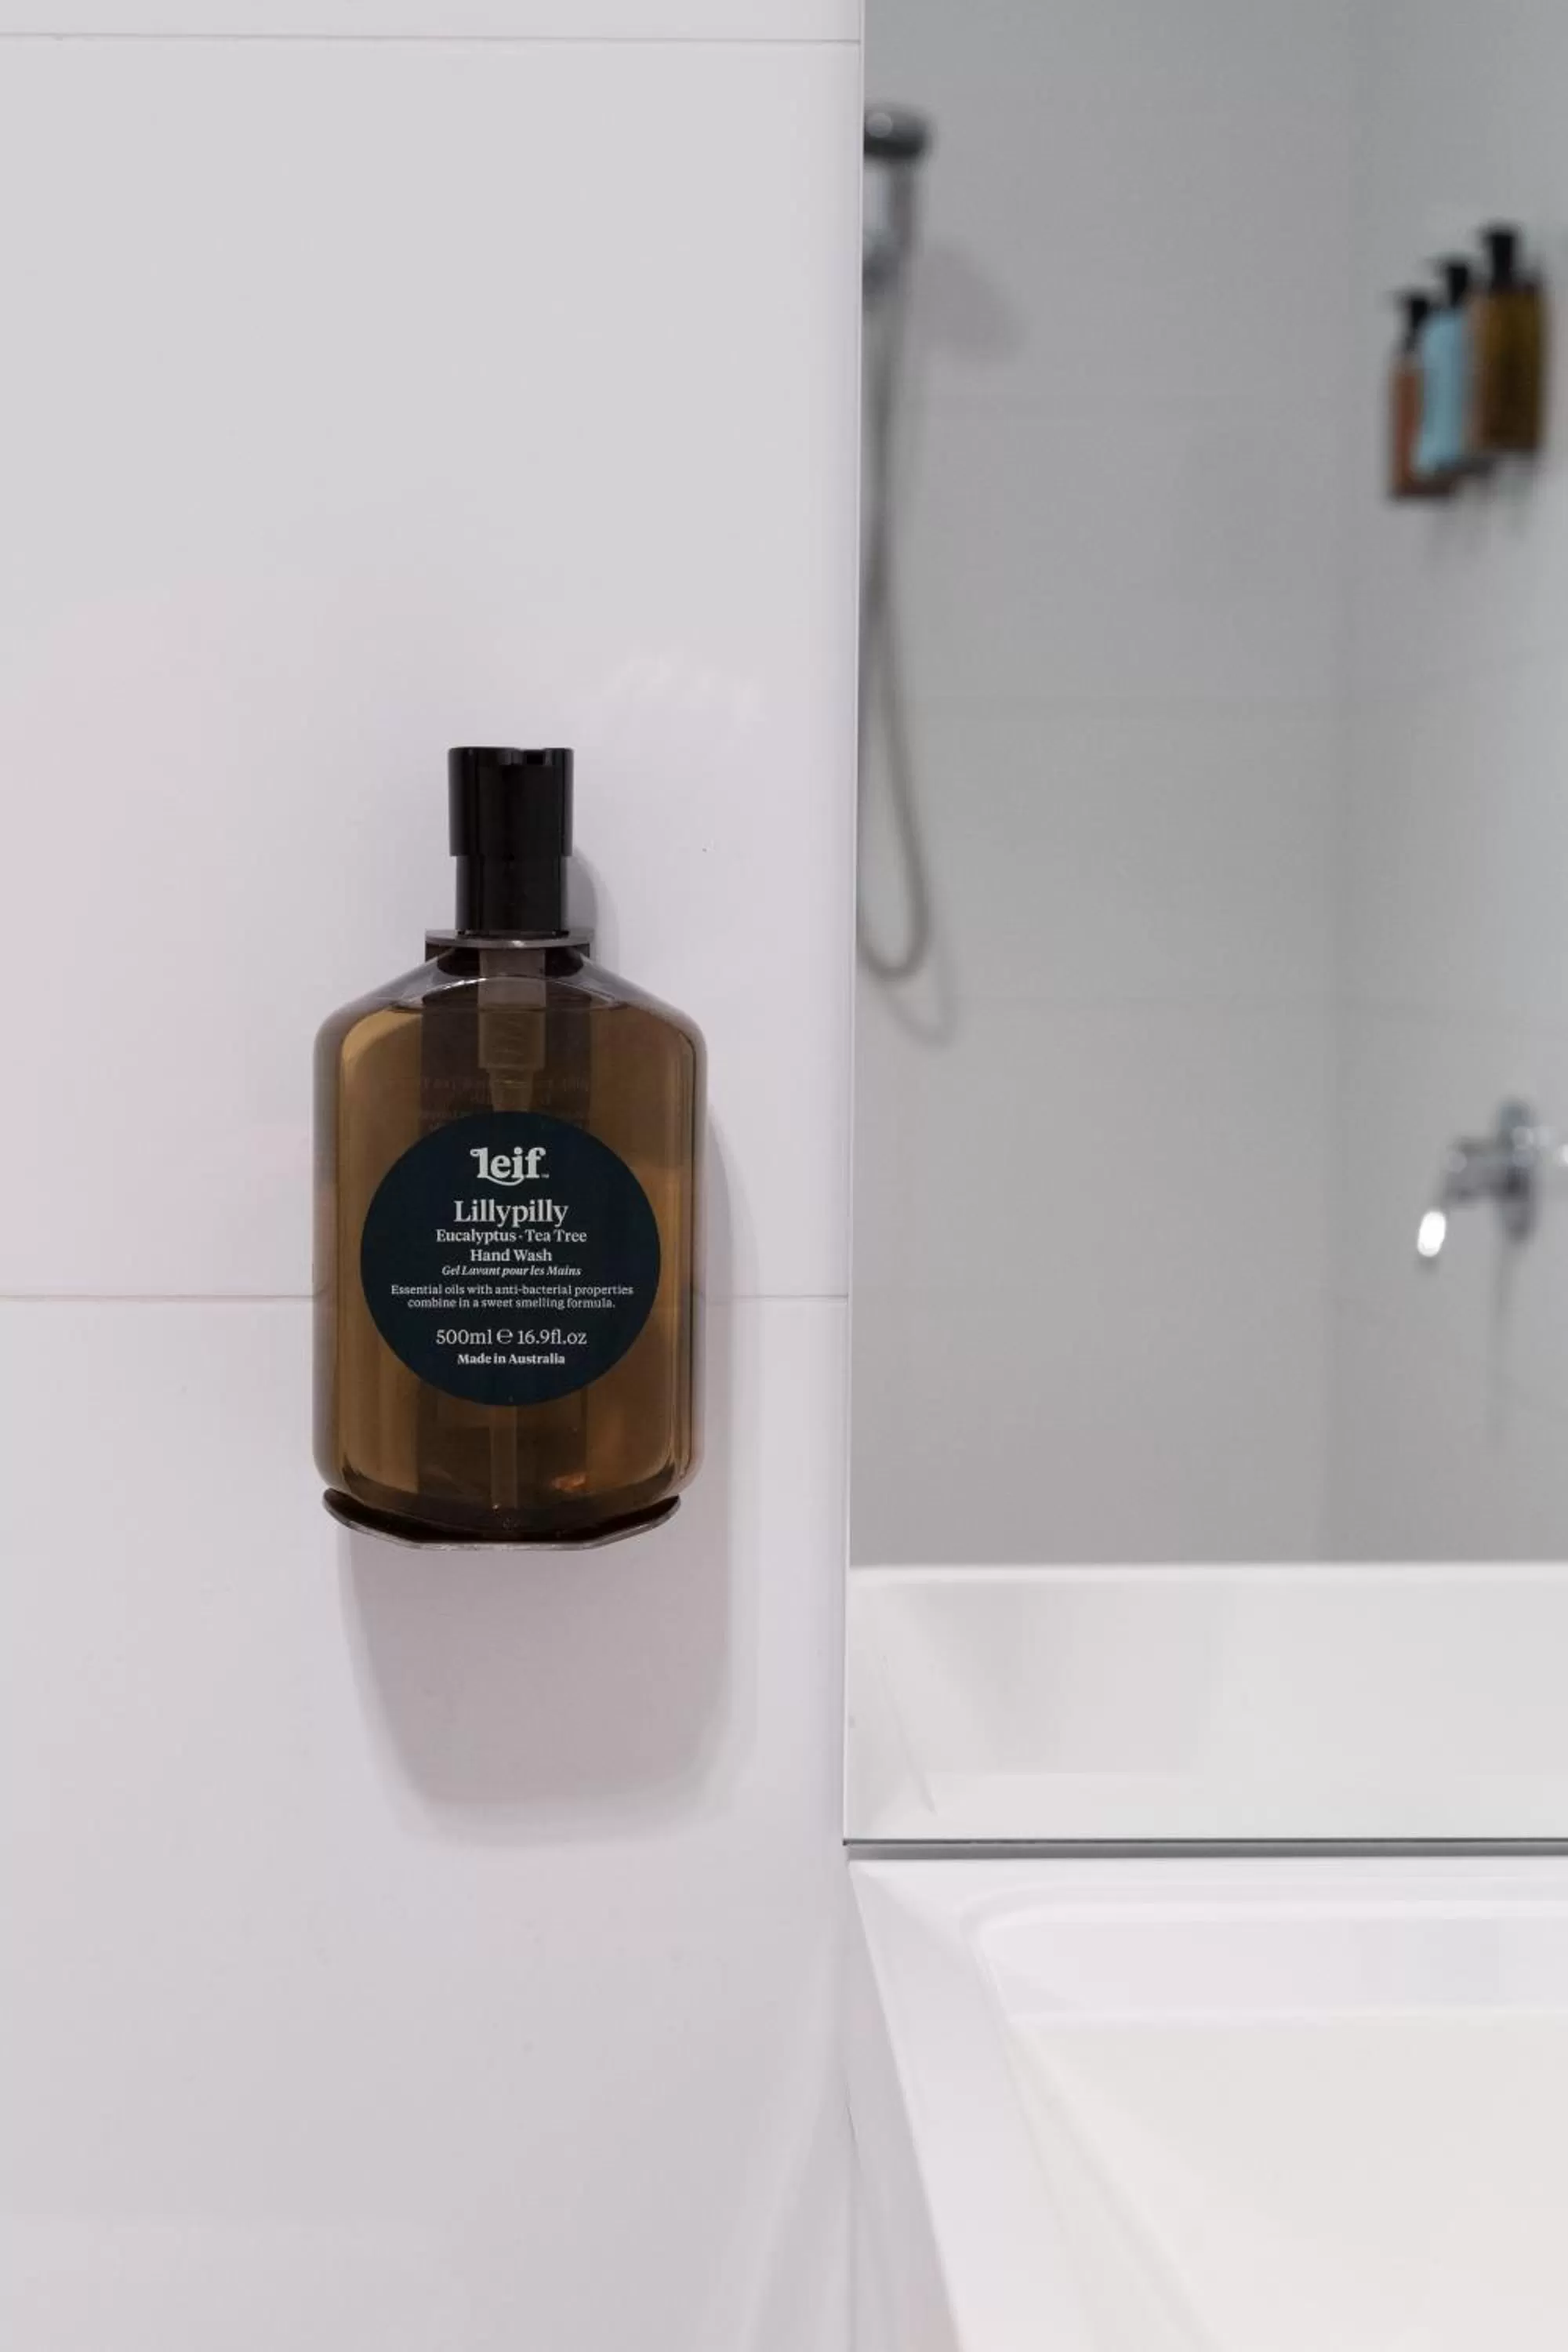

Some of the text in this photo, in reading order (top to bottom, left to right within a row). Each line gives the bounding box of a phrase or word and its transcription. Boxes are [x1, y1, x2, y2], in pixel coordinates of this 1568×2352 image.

[454, 1199, 568, 1228] Lillypilly
[437, 1229, 586, 1243] Eucalyptus Tea Tree
[470, 1249, 552, 1261] Hand Wash
[442, 1265, 581, 1277] Gel Lavant pour les Mains
[391, 1284, 633, 1297] Essential oils with anti-bacterial properties
[408, 1298, 456, 1308] combine
[459, 1298, 470, 1308] in
[516, 1298, 564, 1309] smelling
[568, 1298, 615, 1308] formula.
[436, 1329, 492, 1344] 500ml
[517, 1329, 586, 1344] 16.9fl.oz
[458, 1353, 564, 1364] Made in Australia
